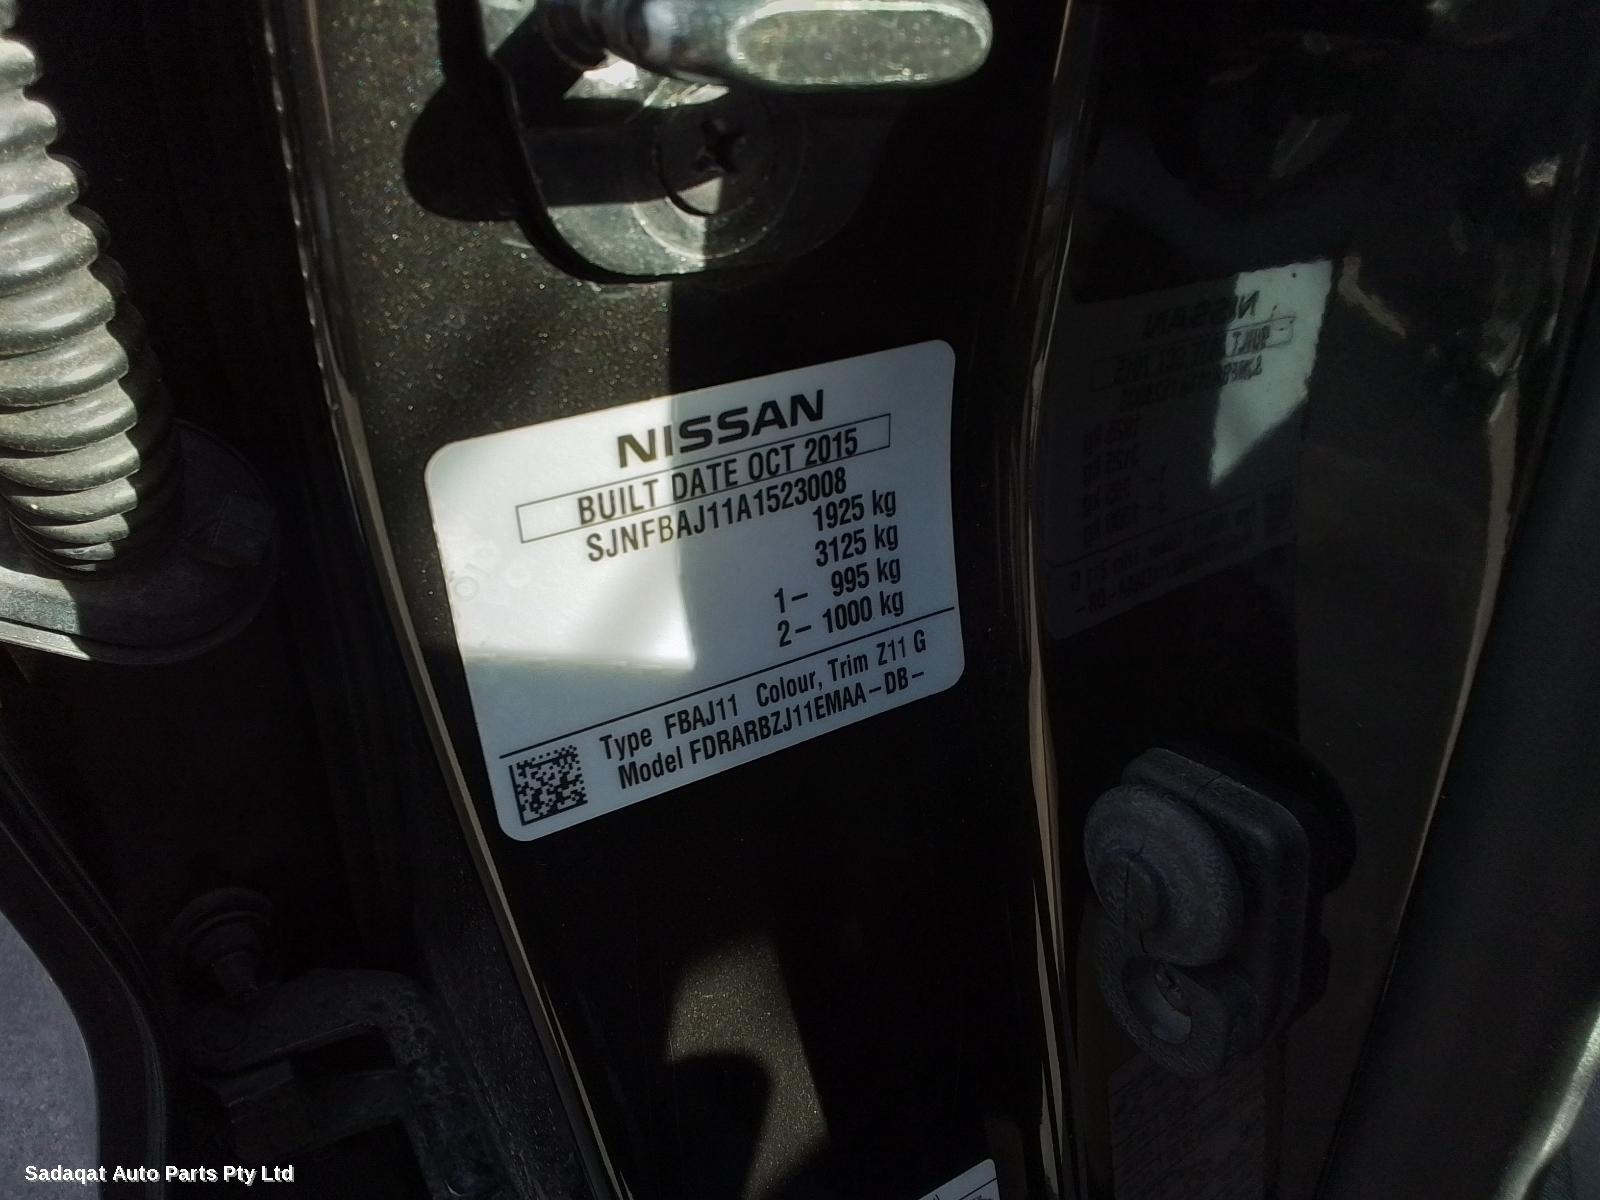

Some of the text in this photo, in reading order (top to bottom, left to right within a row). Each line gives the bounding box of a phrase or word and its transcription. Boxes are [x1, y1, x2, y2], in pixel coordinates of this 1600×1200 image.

[617, 389, 824, 468] NISSAN
[577, 427, 858, 525] BUILT DATE OCT 2015
[586, 466, 847, 562] SJNFBAJ11A1523008
[812, 489, 897, 532] 1925 kg
[815, 524, 899, 567] 3125 kg
[831, 562, 870, 597] 995
[876, 557, 901, 584] kg
[822, 595, 873, 633] 1000
[879, 590, 904, 617] kg
[599, 629, 927, 762] Type FBAJ11 Colour, Trim Z11 G
[618, 748, 684, 790] Model
